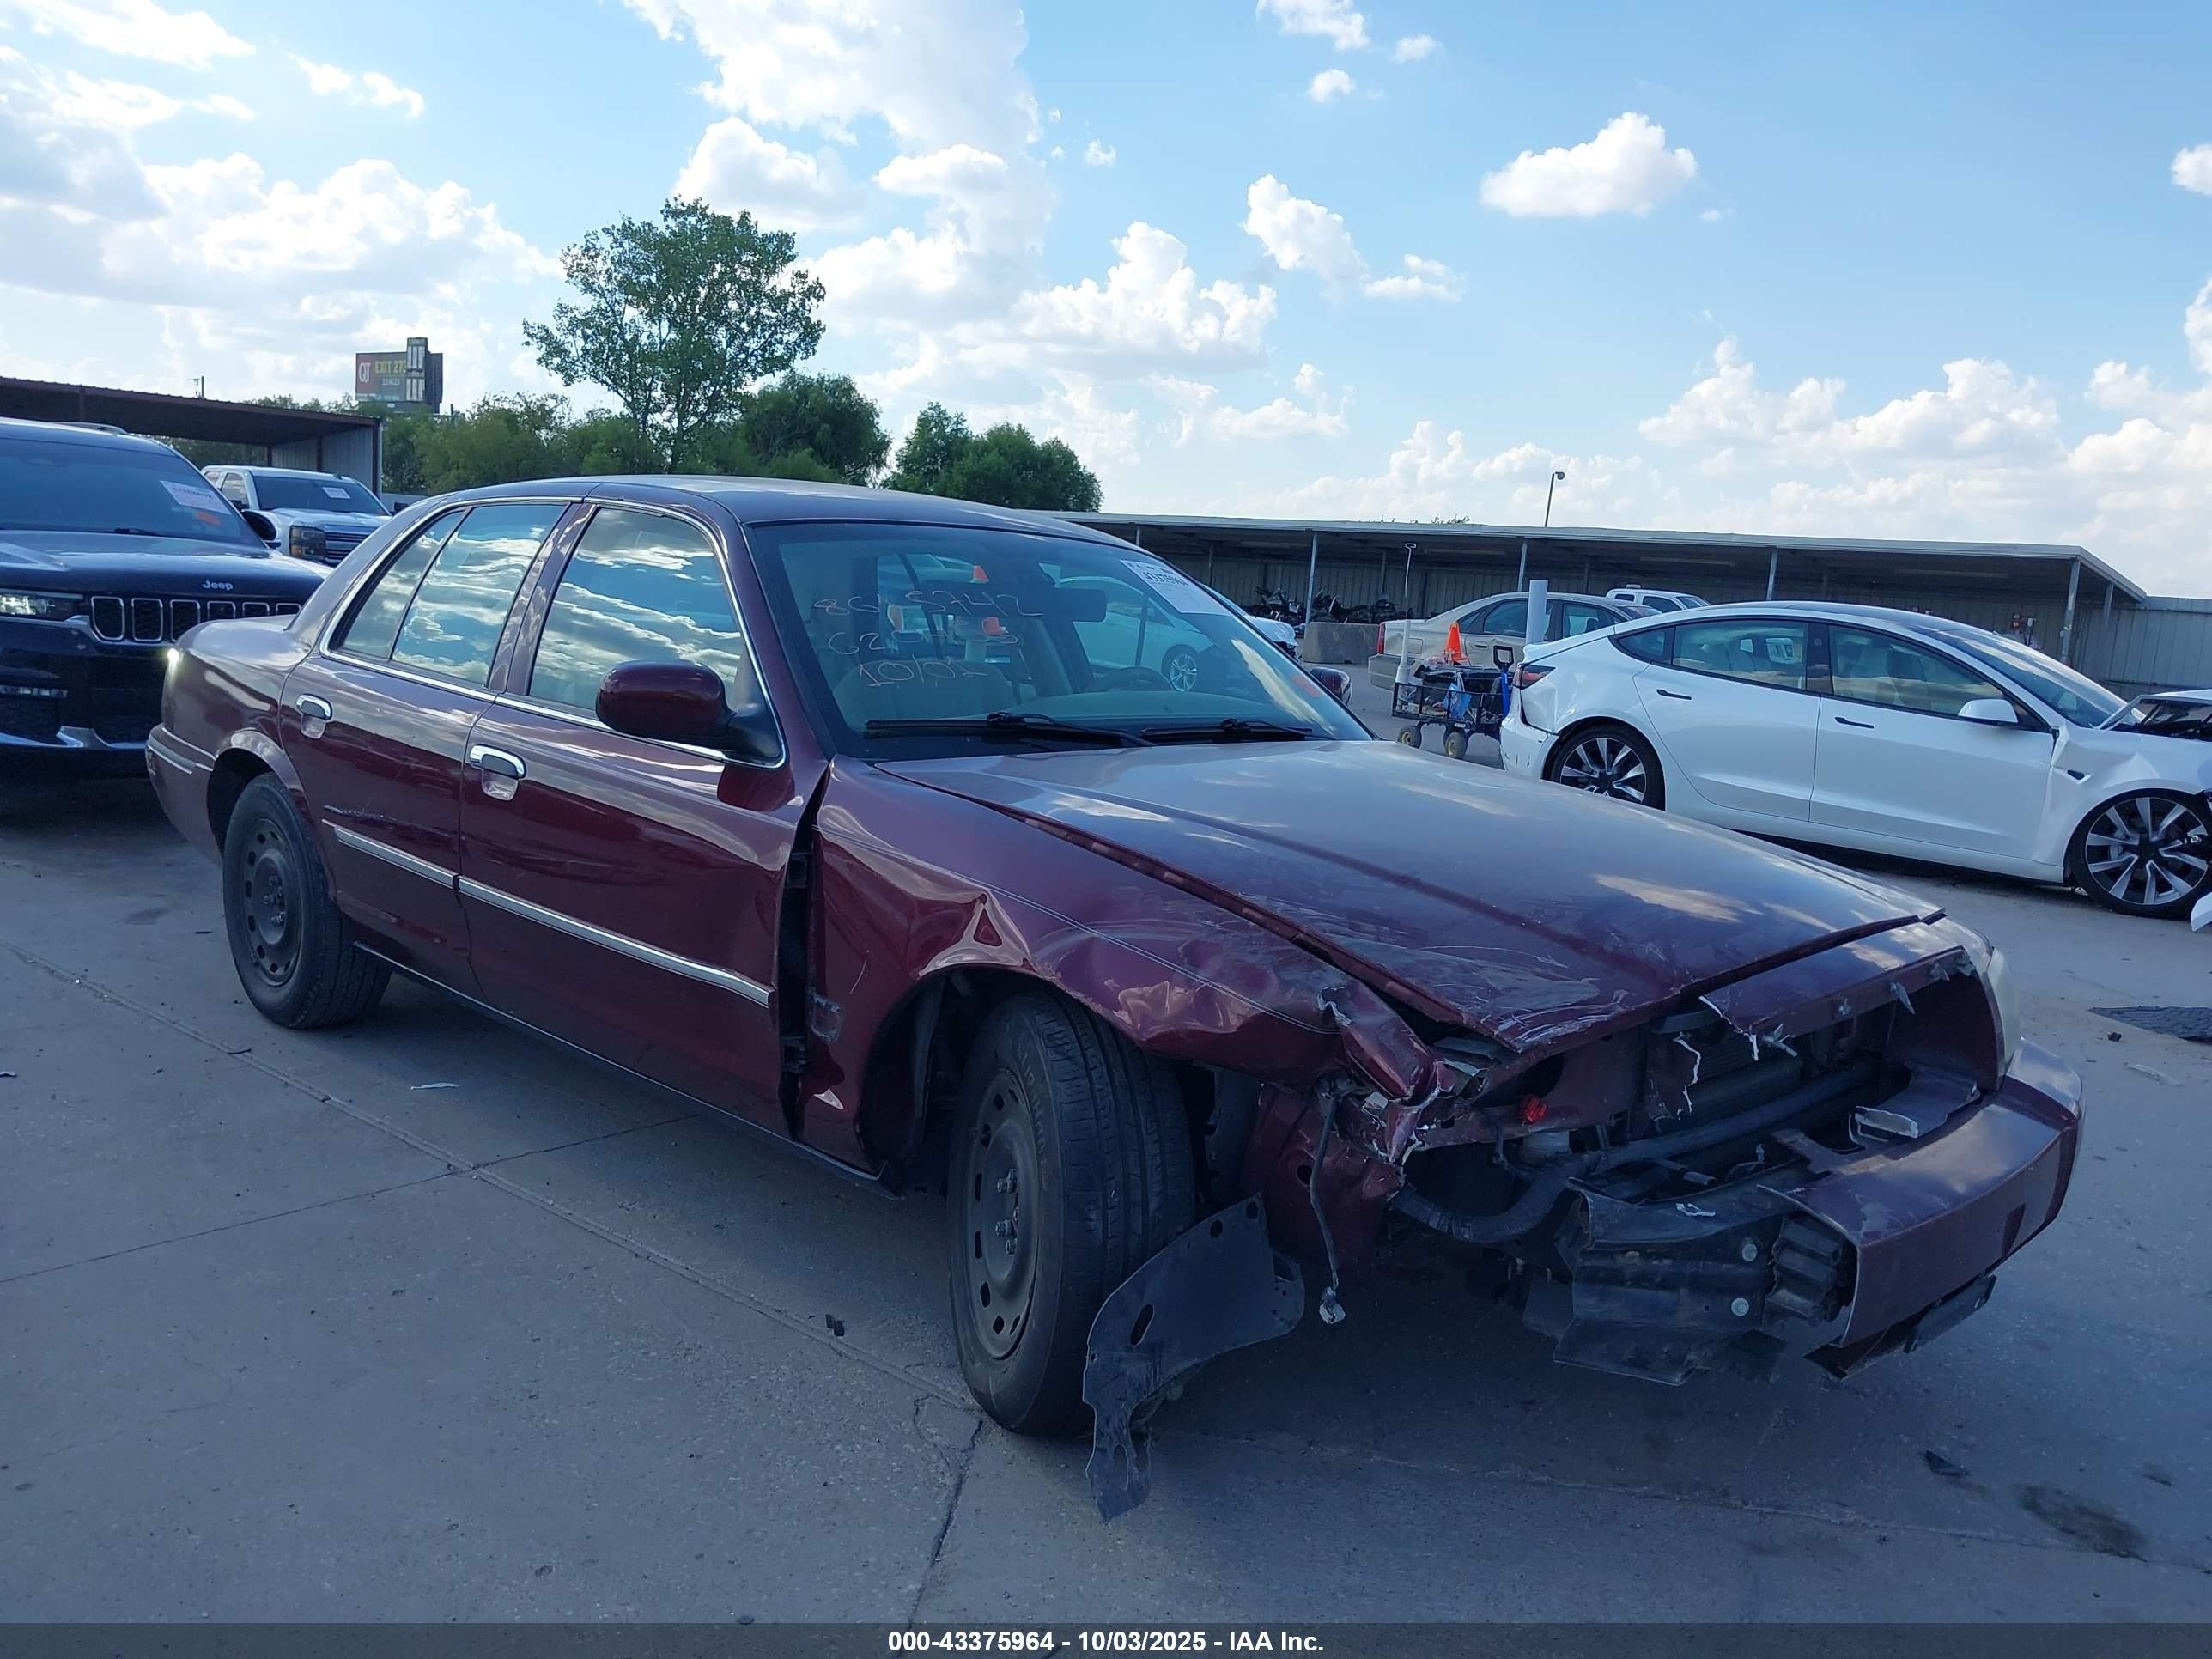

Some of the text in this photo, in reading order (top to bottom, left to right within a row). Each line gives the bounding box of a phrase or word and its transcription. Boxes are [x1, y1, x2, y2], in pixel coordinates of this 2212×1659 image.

[358, 362, 371, 383] QT
[374, 361, 392, 374] EXIT
[202, 580, 234, 591] Jeep
